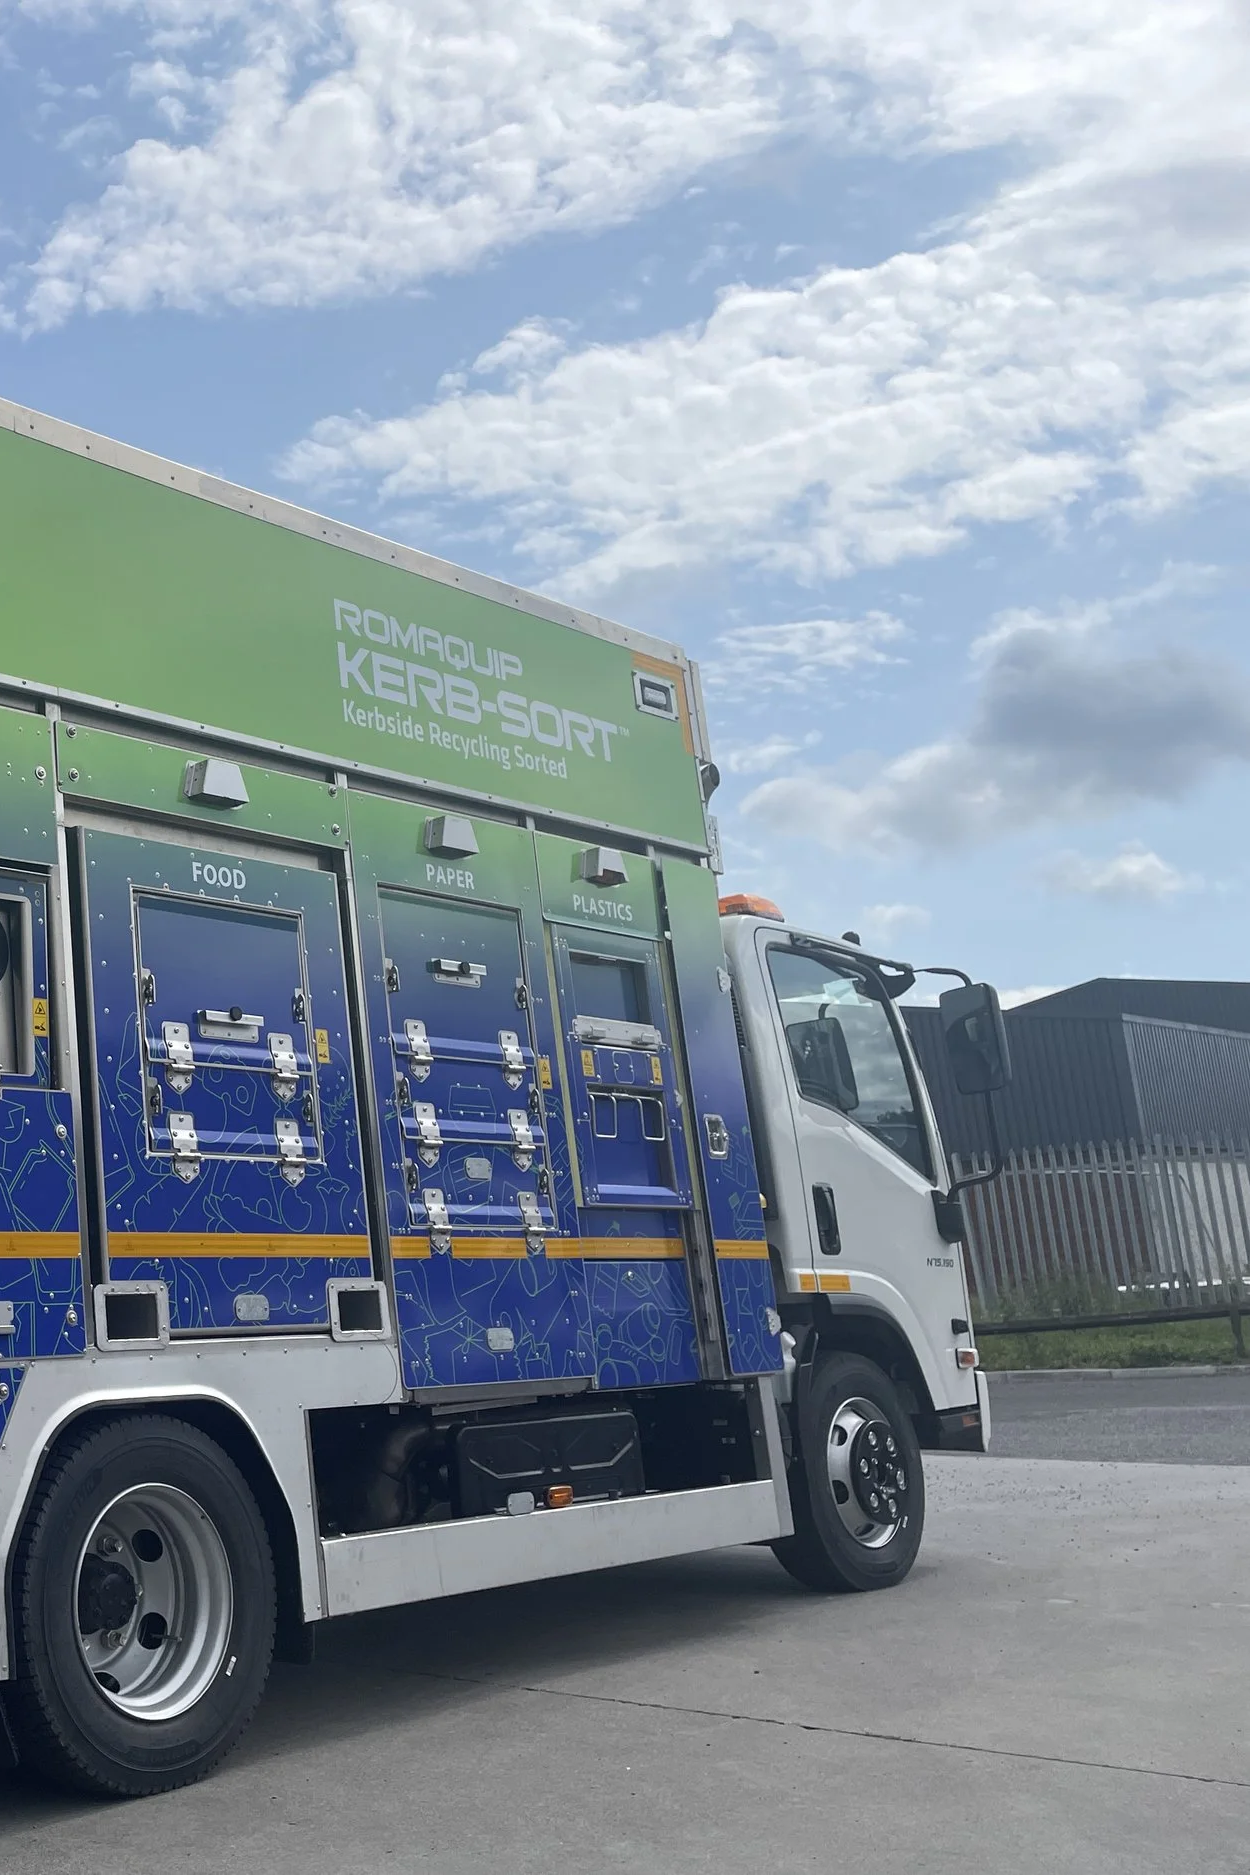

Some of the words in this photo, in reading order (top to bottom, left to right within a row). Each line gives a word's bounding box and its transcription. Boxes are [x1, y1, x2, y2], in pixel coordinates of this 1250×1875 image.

[334, 598, 523, 680] ROMAQUIP
[337, 641, 617, 762] KERB-SORT
[343, 698, 424, 742] Kerbside
[430, 721, 510, 770] Recycling
[514, 745, 568, 779] Sorted
[192, 861, 246, 889] FOOD
[425, 863, 475, 890] PAPER
[572, 894, 633, 922] PLASTICS
